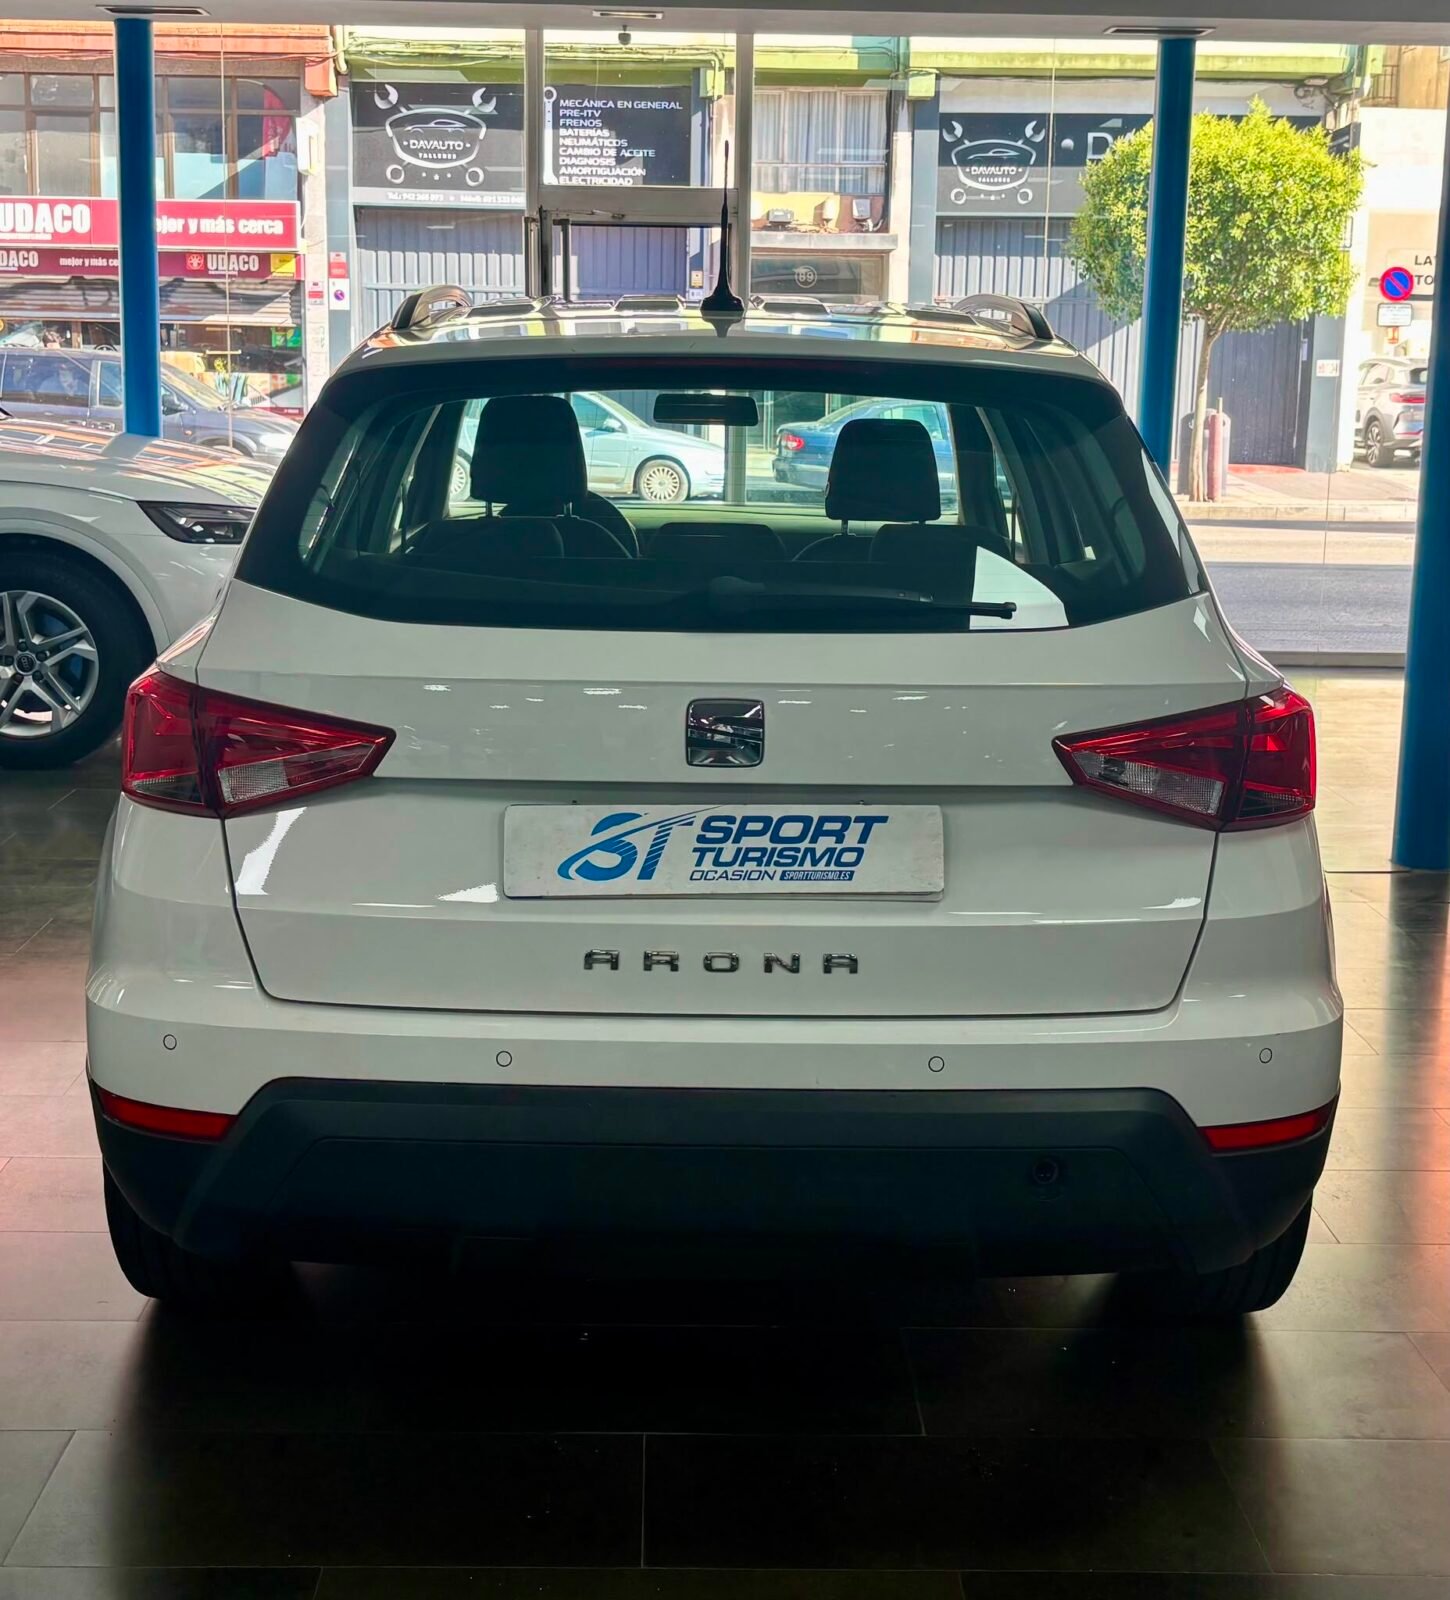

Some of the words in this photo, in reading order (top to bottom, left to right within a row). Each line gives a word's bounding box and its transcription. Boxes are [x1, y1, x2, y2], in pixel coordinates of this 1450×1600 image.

[560, 98, 614, 108] MECÁNICA
[617, 100, 632, 109] EN
[634, 101, 683, 110] GENERAL
[560, 119, 602, 127] FRENOS
[559, 127, 610, 137] BATERÍAS
[409, 139, 464, 150] DAVAUTO
[559, 137, 628, 147] NEUMÁTICOS
[559, 147, 601, 156] CAMBIO
[602, 148, 617, 157] DE
[620, 149, 656, 157] ACEITE
[559, 157, 616, 166] DIAGNOSIS
[559, 166, 646, 176] AMORTIGUACIÓN
[971, 166, 1017, 174] DAVAUTO
[559, 176, 633, 186] ELECTRICIDAD
[0, 202, 91, 234] UDACO
[188, 218, 198, 234] y
[200, 216, 235, 233] más
[238, 219, 283, 234] cerca
[59, 257, 83, 267] mejor
[84, 258, 90, 267] y
[90, 257, 107, 266] más
[206, 254, 259, 271] UDACO
[696, 815, 889, 845] SPORT
[692, 847, 865, 868] TURISMO
[689, 869, 777, 881] OCASION
[782, 871, 852, 881] SPORTTURISMO.ES
[583, 948, 859, 975] ARONA
